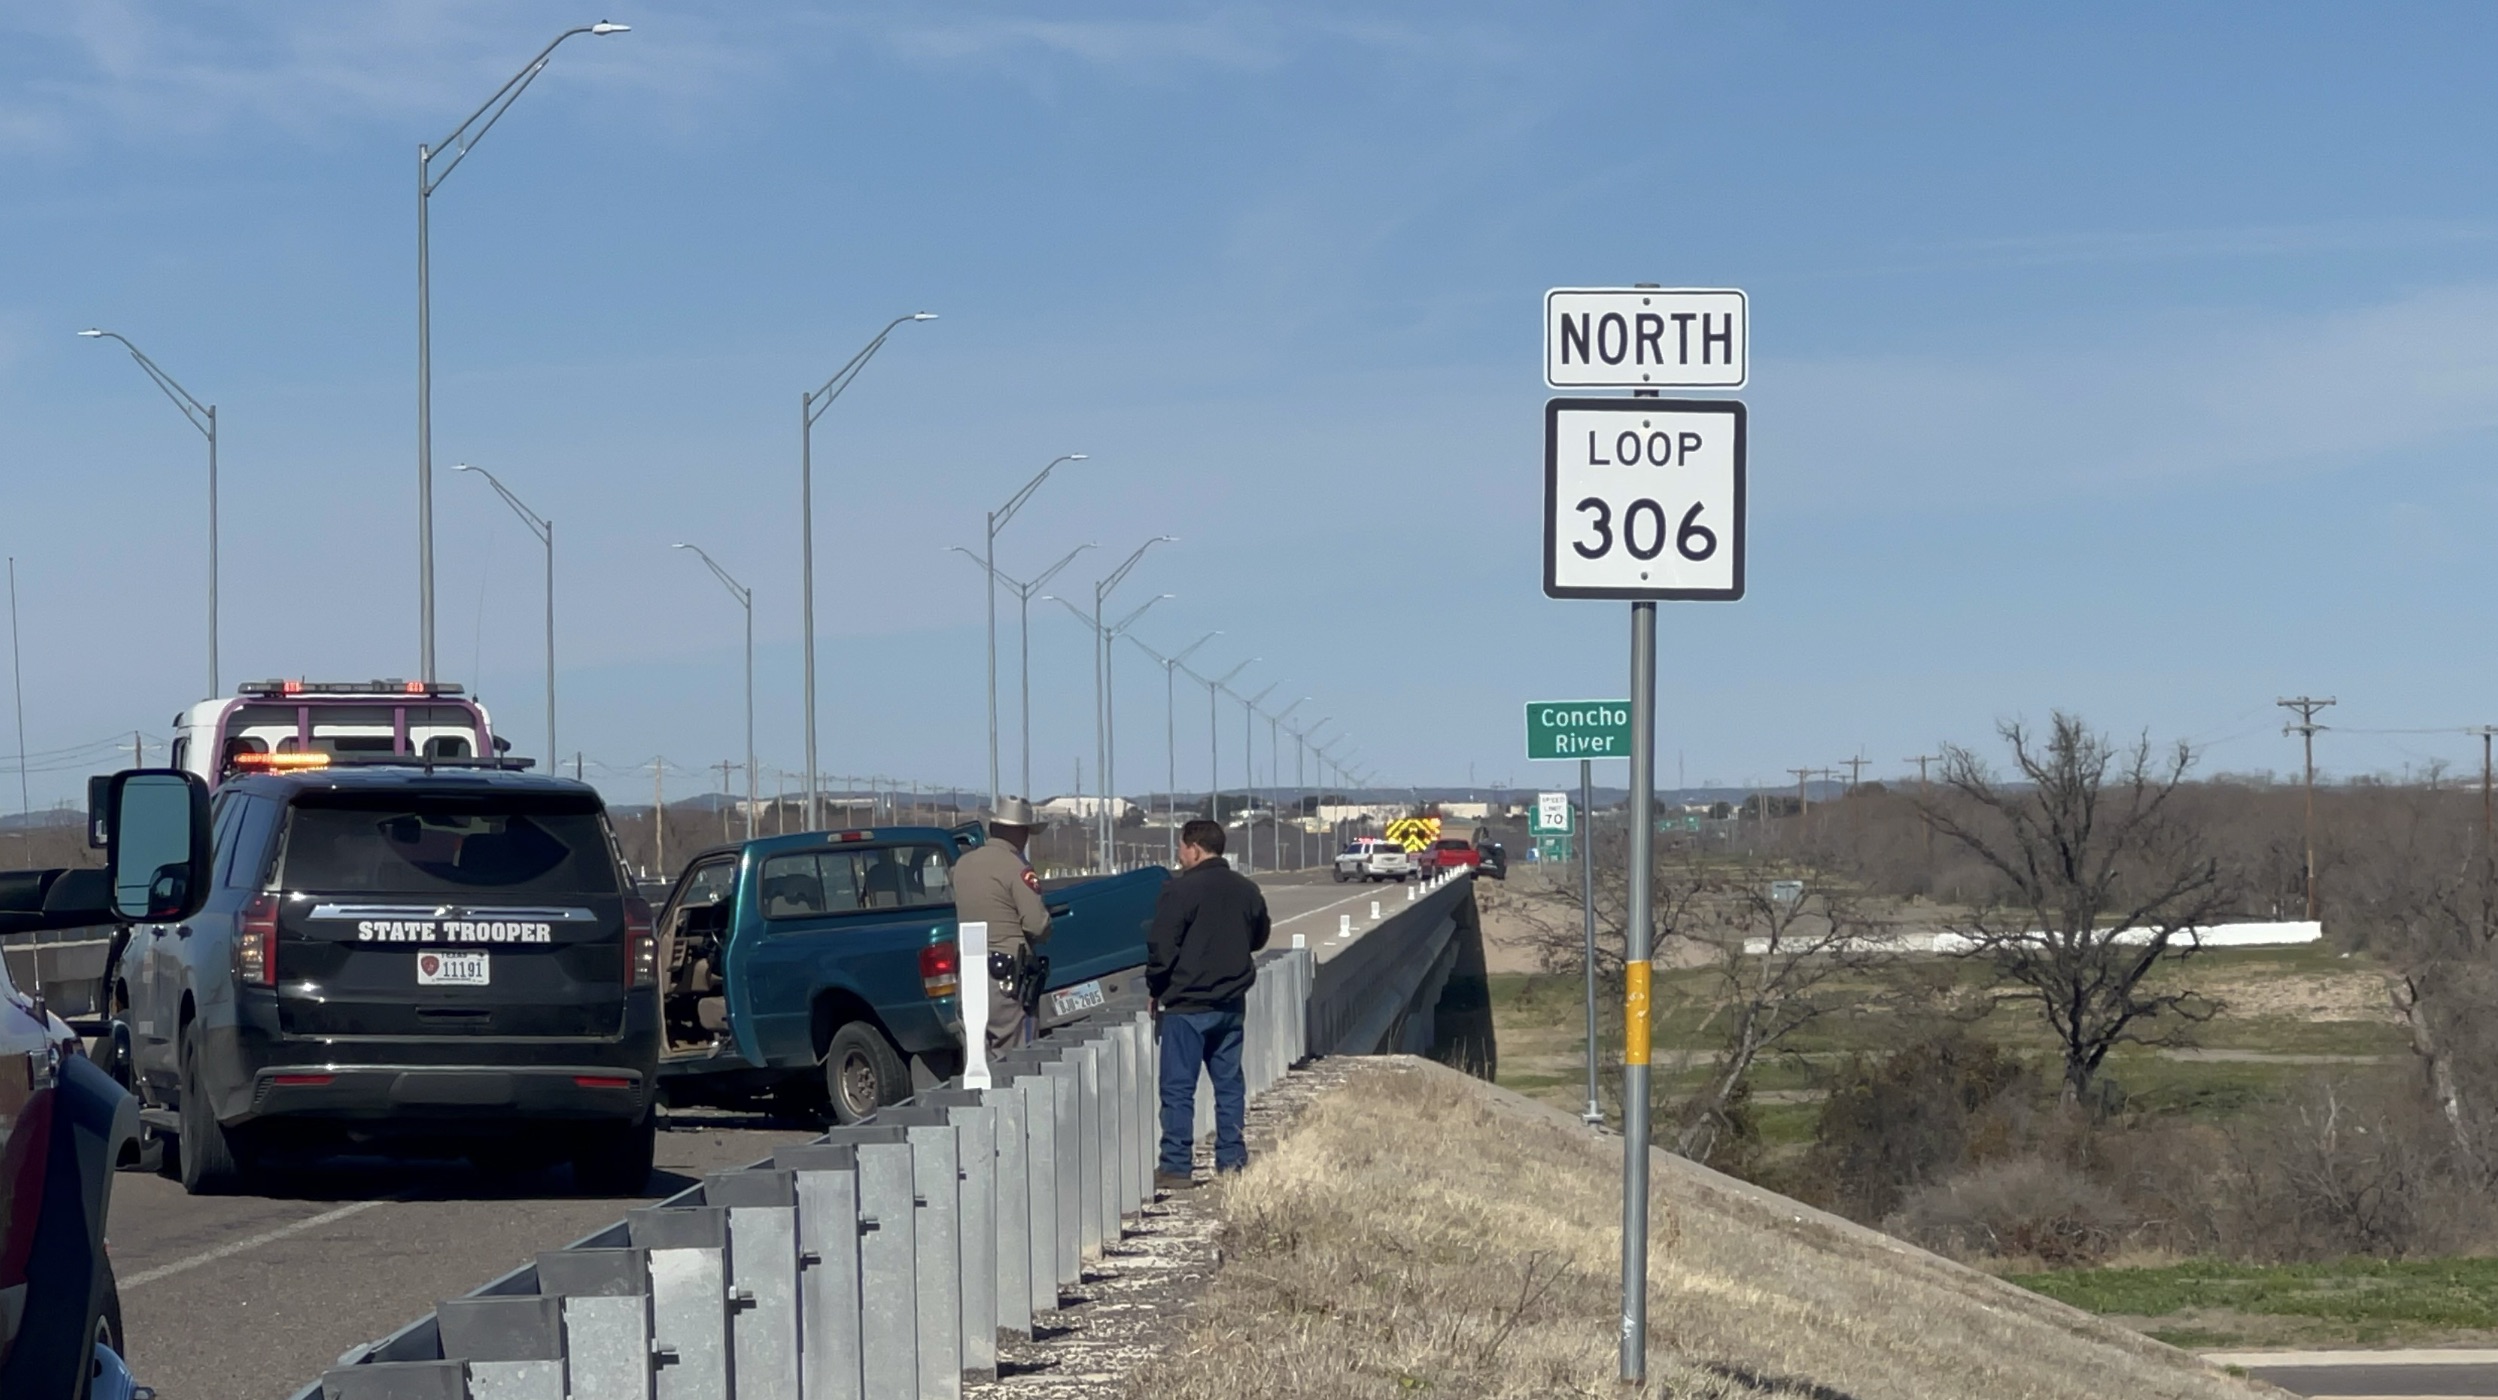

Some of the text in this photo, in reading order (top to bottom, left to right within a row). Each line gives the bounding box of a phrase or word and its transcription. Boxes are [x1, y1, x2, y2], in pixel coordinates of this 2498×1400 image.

[1560, 312, 1733, 365] NORTH
[1588, 430, 1703, 467] LOOP
[1572, 496, 1718, 562] 306
[1541, 706, 1627, 727] Concho
[1555, 732, 1614, 753] River
[1545, 813, 1564, 825] 70
[358, 921, 551, 943] STATE TROOPER
[443, 961, 482, 977] 11191
